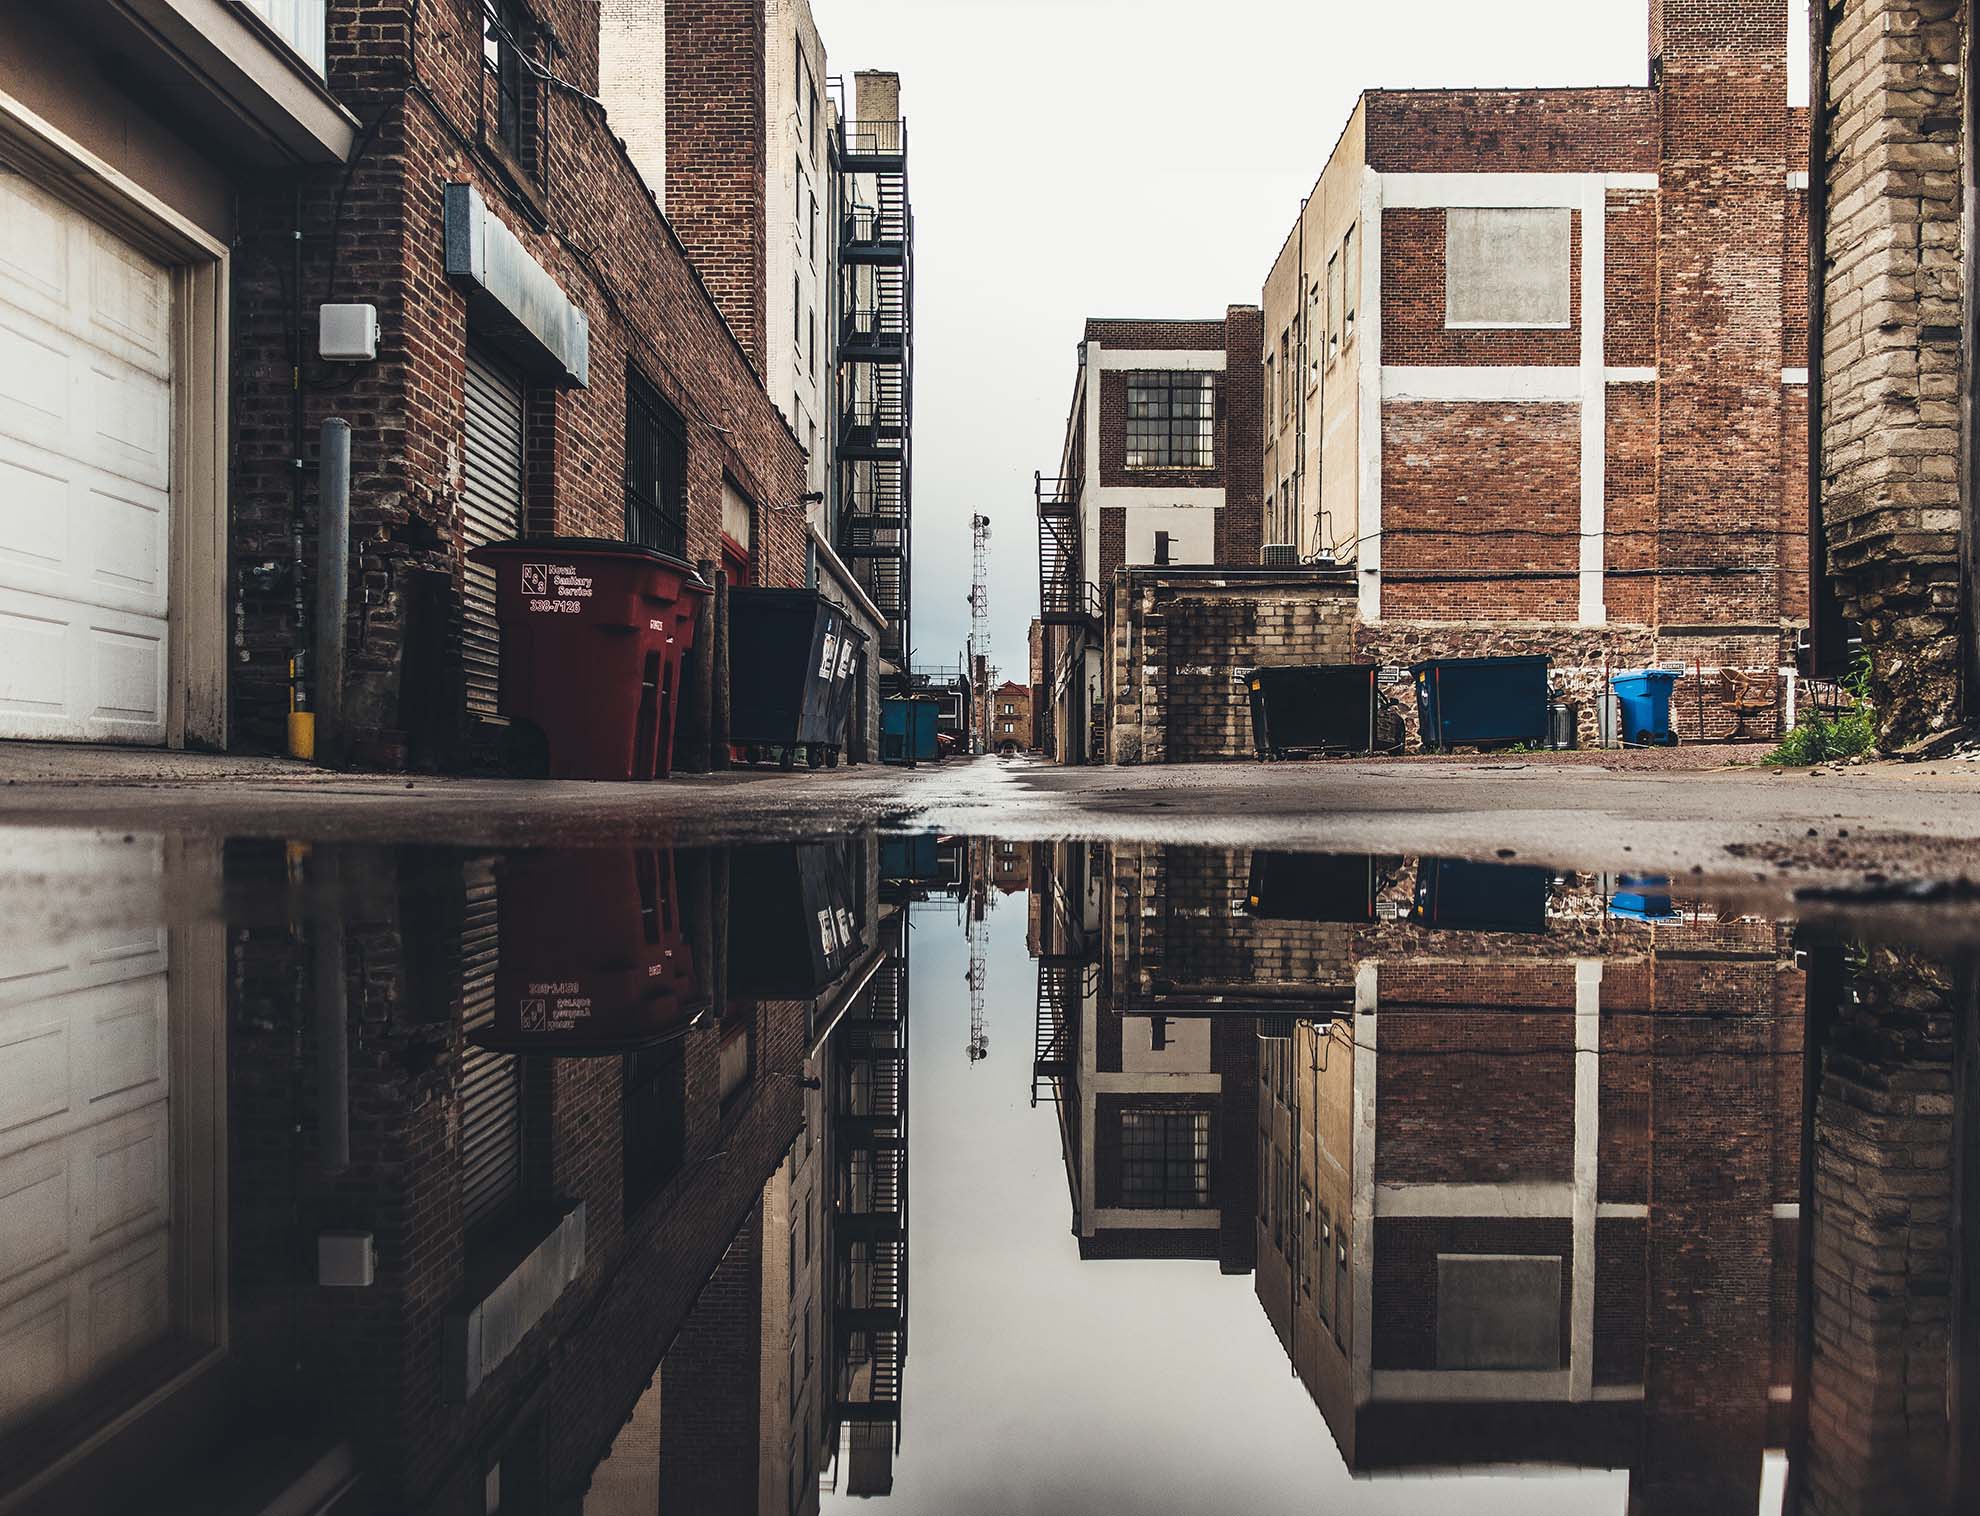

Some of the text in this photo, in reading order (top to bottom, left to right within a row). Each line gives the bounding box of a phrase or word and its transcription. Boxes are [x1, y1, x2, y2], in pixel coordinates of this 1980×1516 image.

[548, 564, 576, 575] Novak
[554, 575, 593, 588] Sanitary
[558, 585, 593, 597] Service
[529, 599, 581, 614] 338-7126
